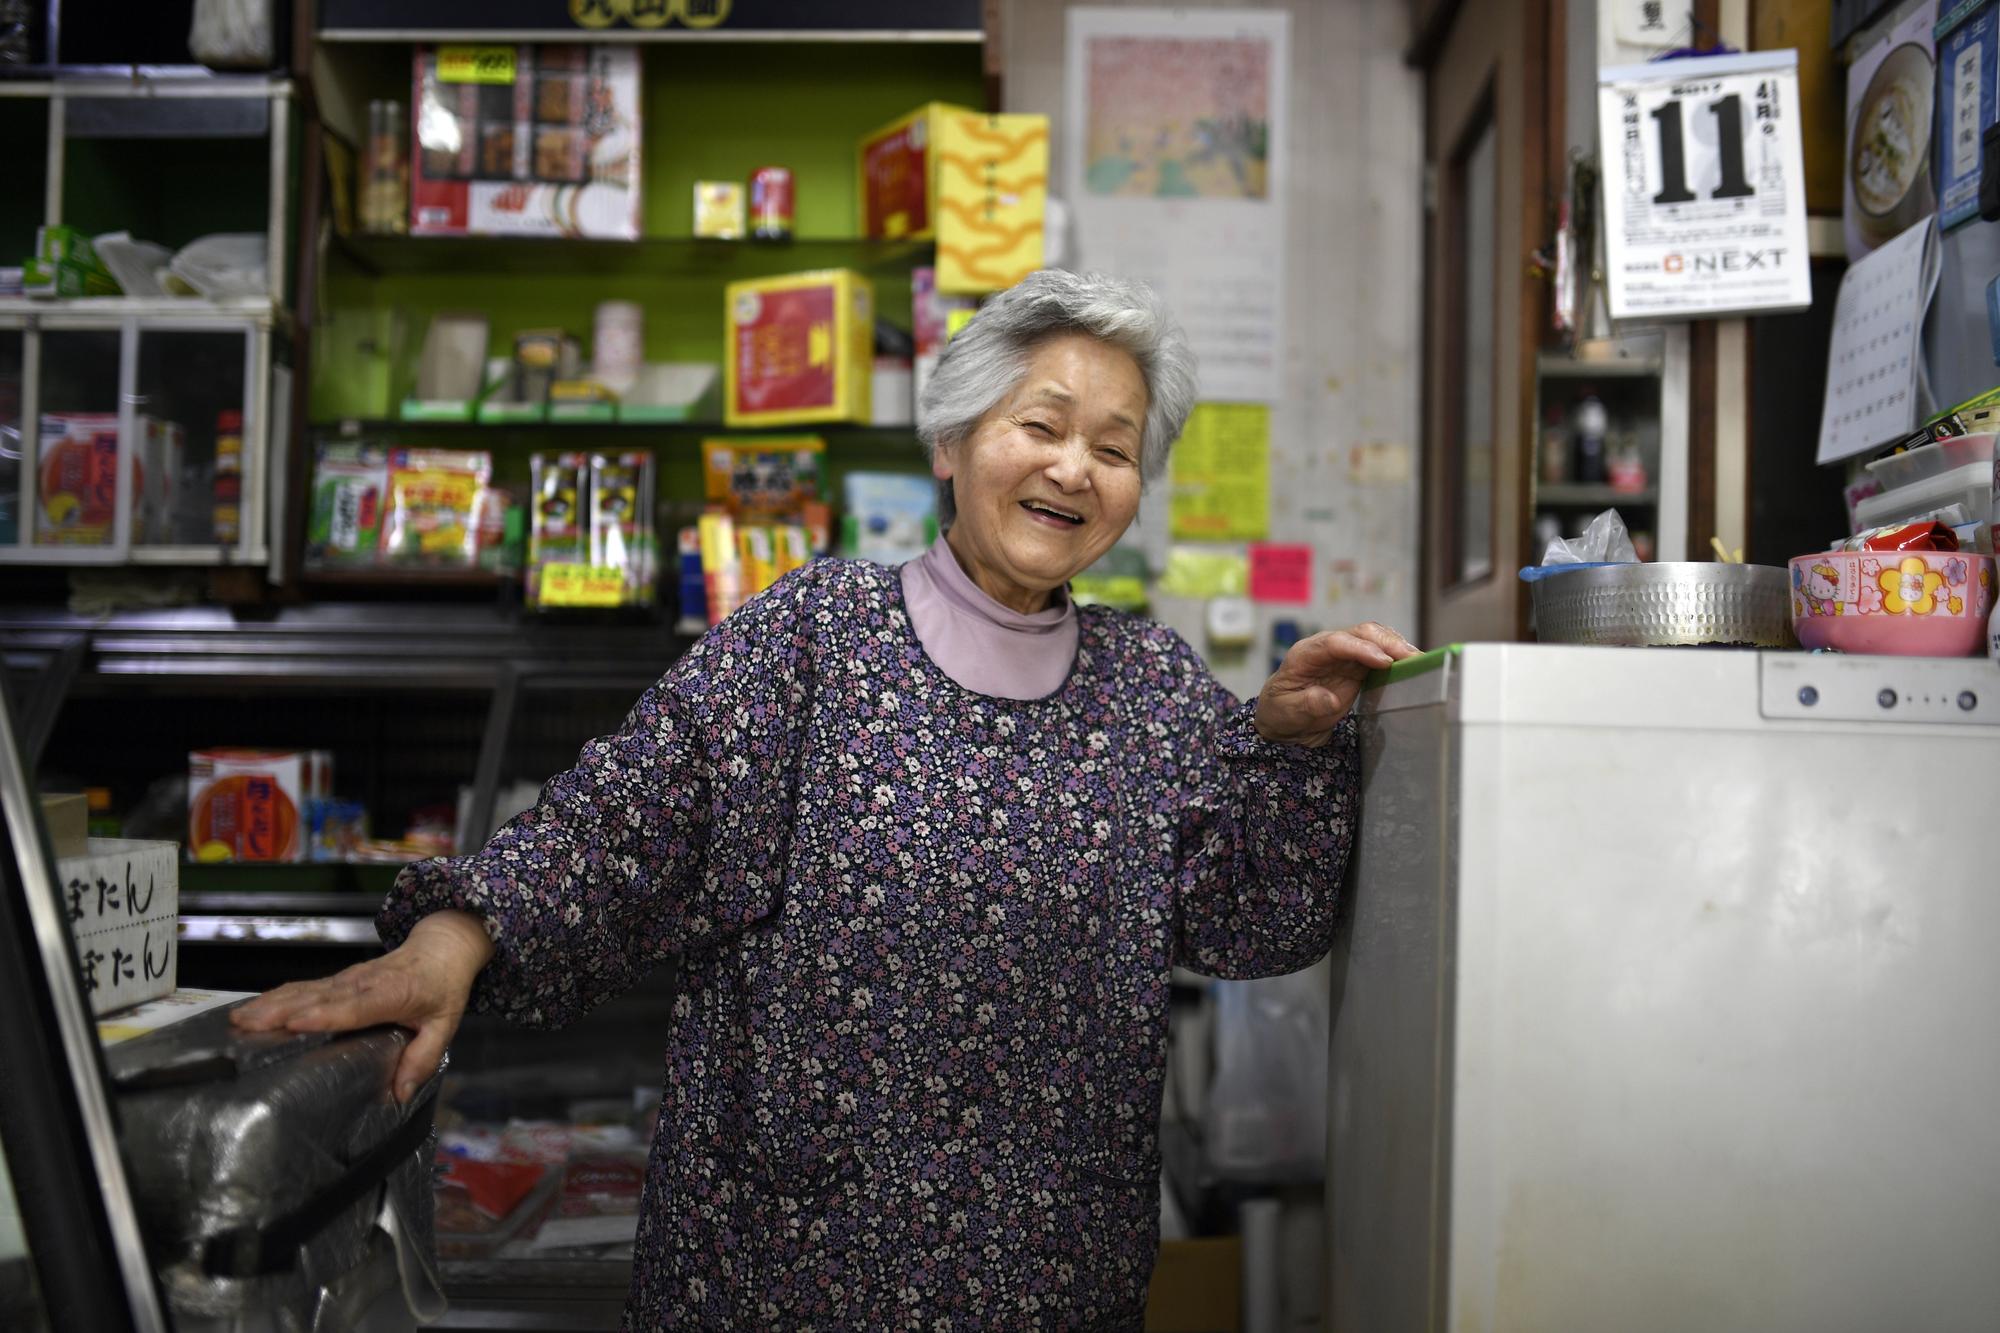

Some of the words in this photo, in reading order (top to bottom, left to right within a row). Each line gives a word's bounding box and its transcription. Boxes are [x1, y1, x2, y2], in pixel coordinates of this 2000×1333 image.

[1756, 80, 1771, 119] 4月
[1651, 94, 1754, 204] 11
[1694, 249, 1788, 273] NEXT
